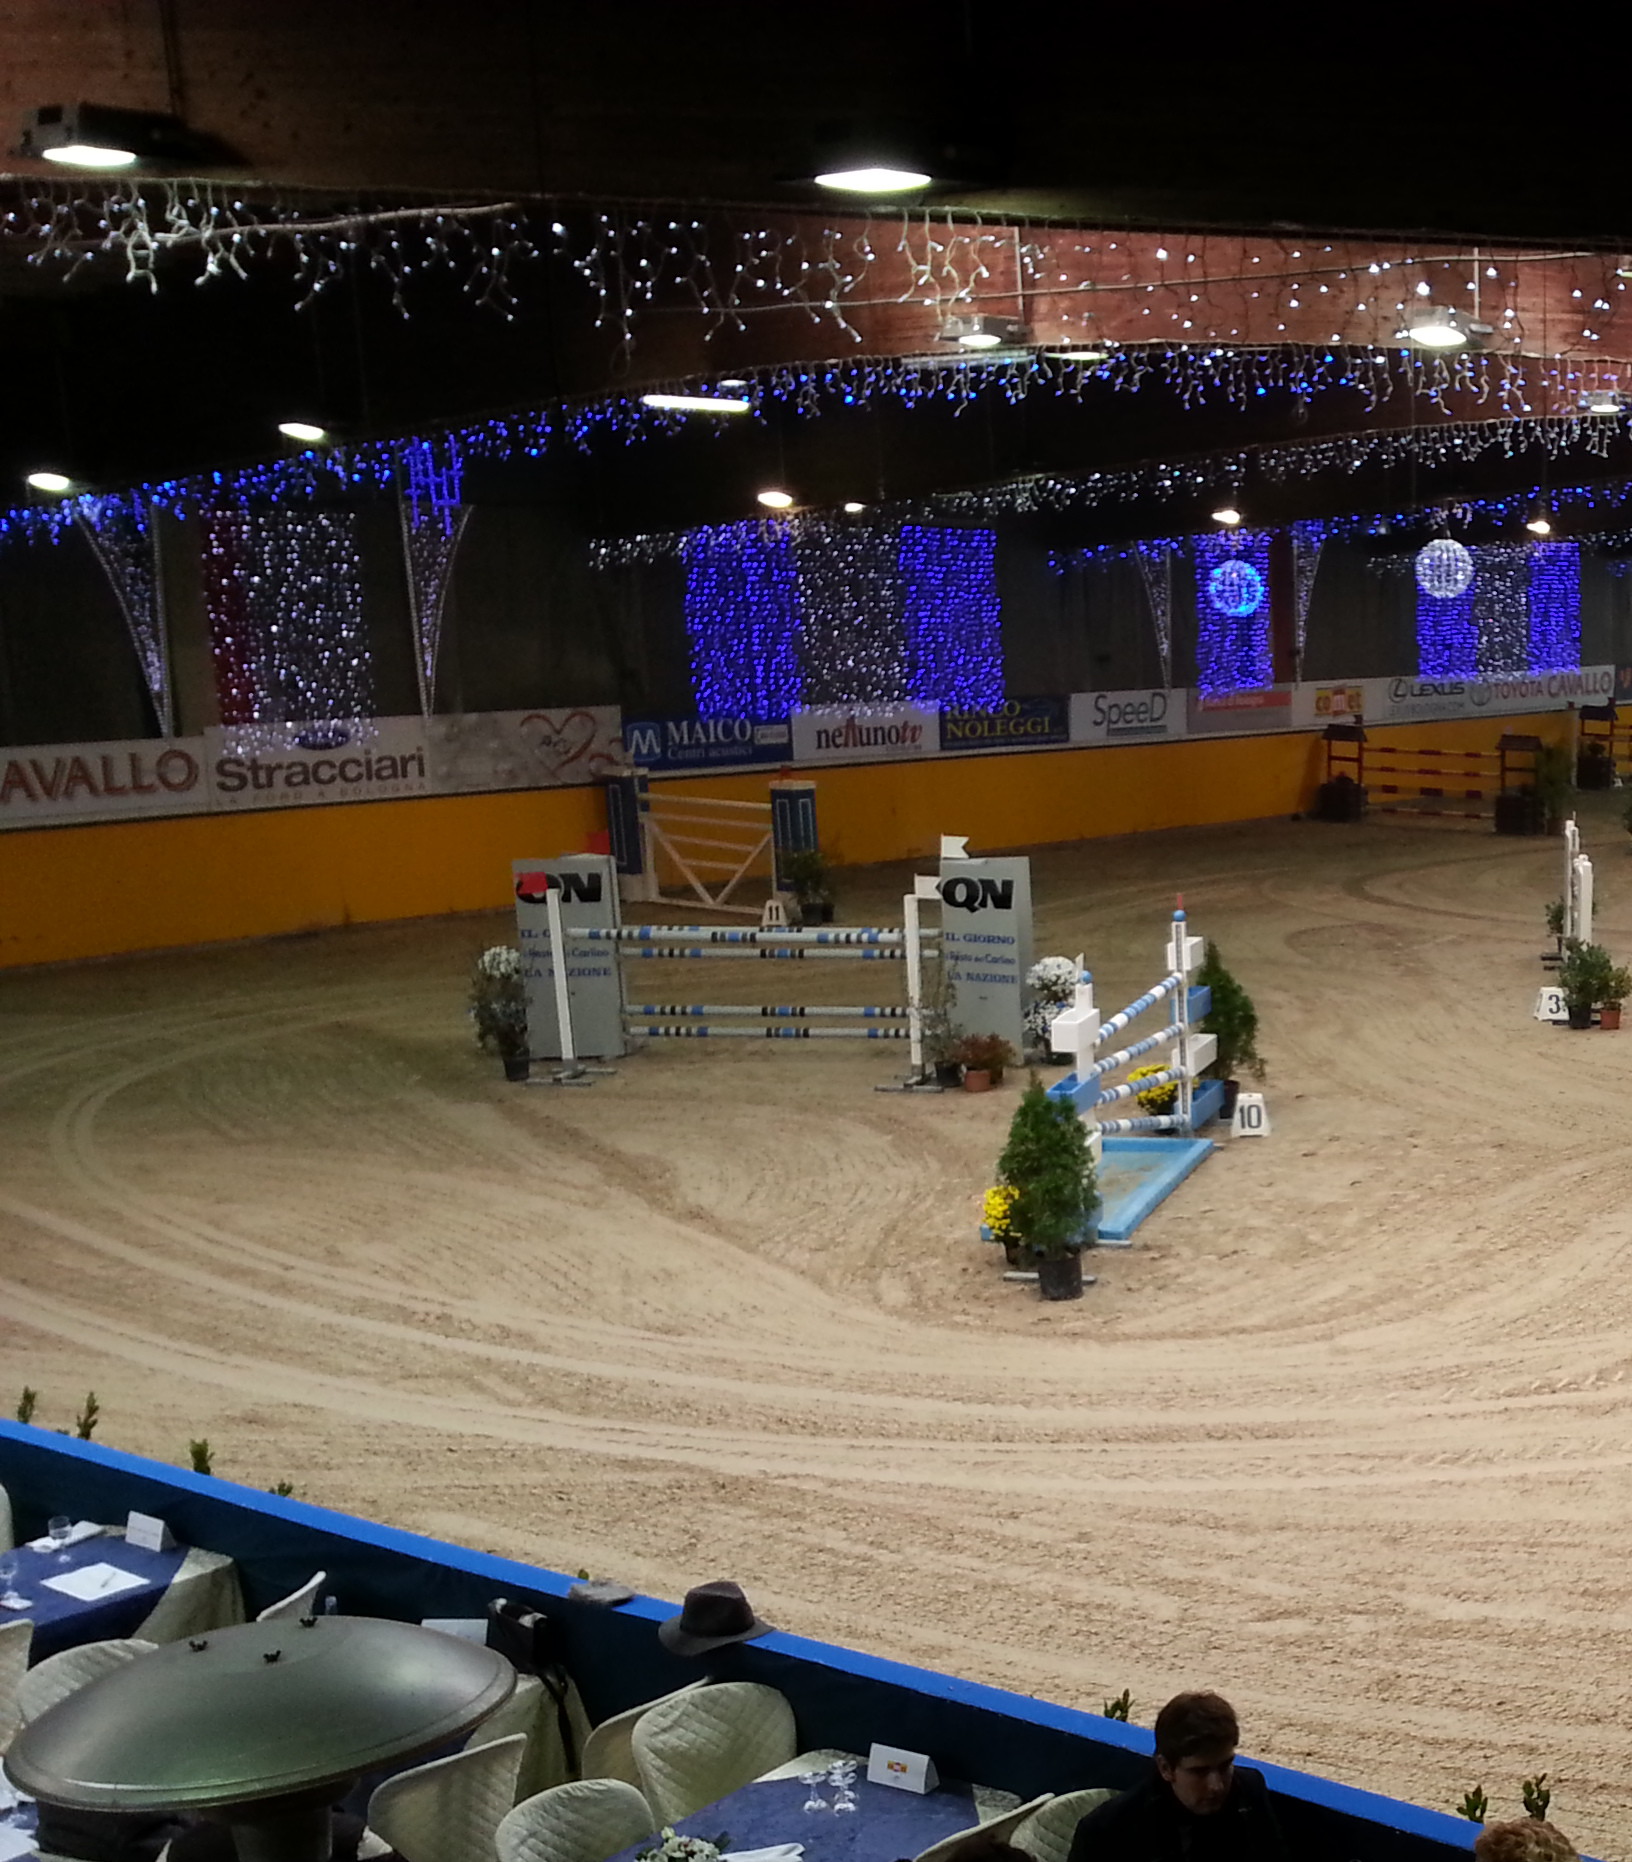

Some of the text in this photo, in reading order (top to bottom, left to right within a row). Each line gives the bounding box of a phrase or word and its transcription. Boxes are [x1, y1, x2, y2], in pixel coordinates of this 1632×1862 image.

[1411, 682, 1465, 698] LEXUS
[1493, 670, 1613, 700] TOYOTA CAVALLO
[1092, 692, 1168, 736] SpeeD
[666, 718, 752, 746] MAICO
[946, 717, 1051, 739] NOLEGGI
[0, 749, 200, 804] AVALLO
[215, 746, 426, 793] Stracciari
[941, 876, 1015, 914] QN
[768, 904, 780, 922] 11
[945, 931, 1016, 946] IL GIORNO
[965, 971, 1018, 985] NAZIONE
[1548, 993, 1561, 1015] 3
[1239, 1103, 1262, 1130] 10
